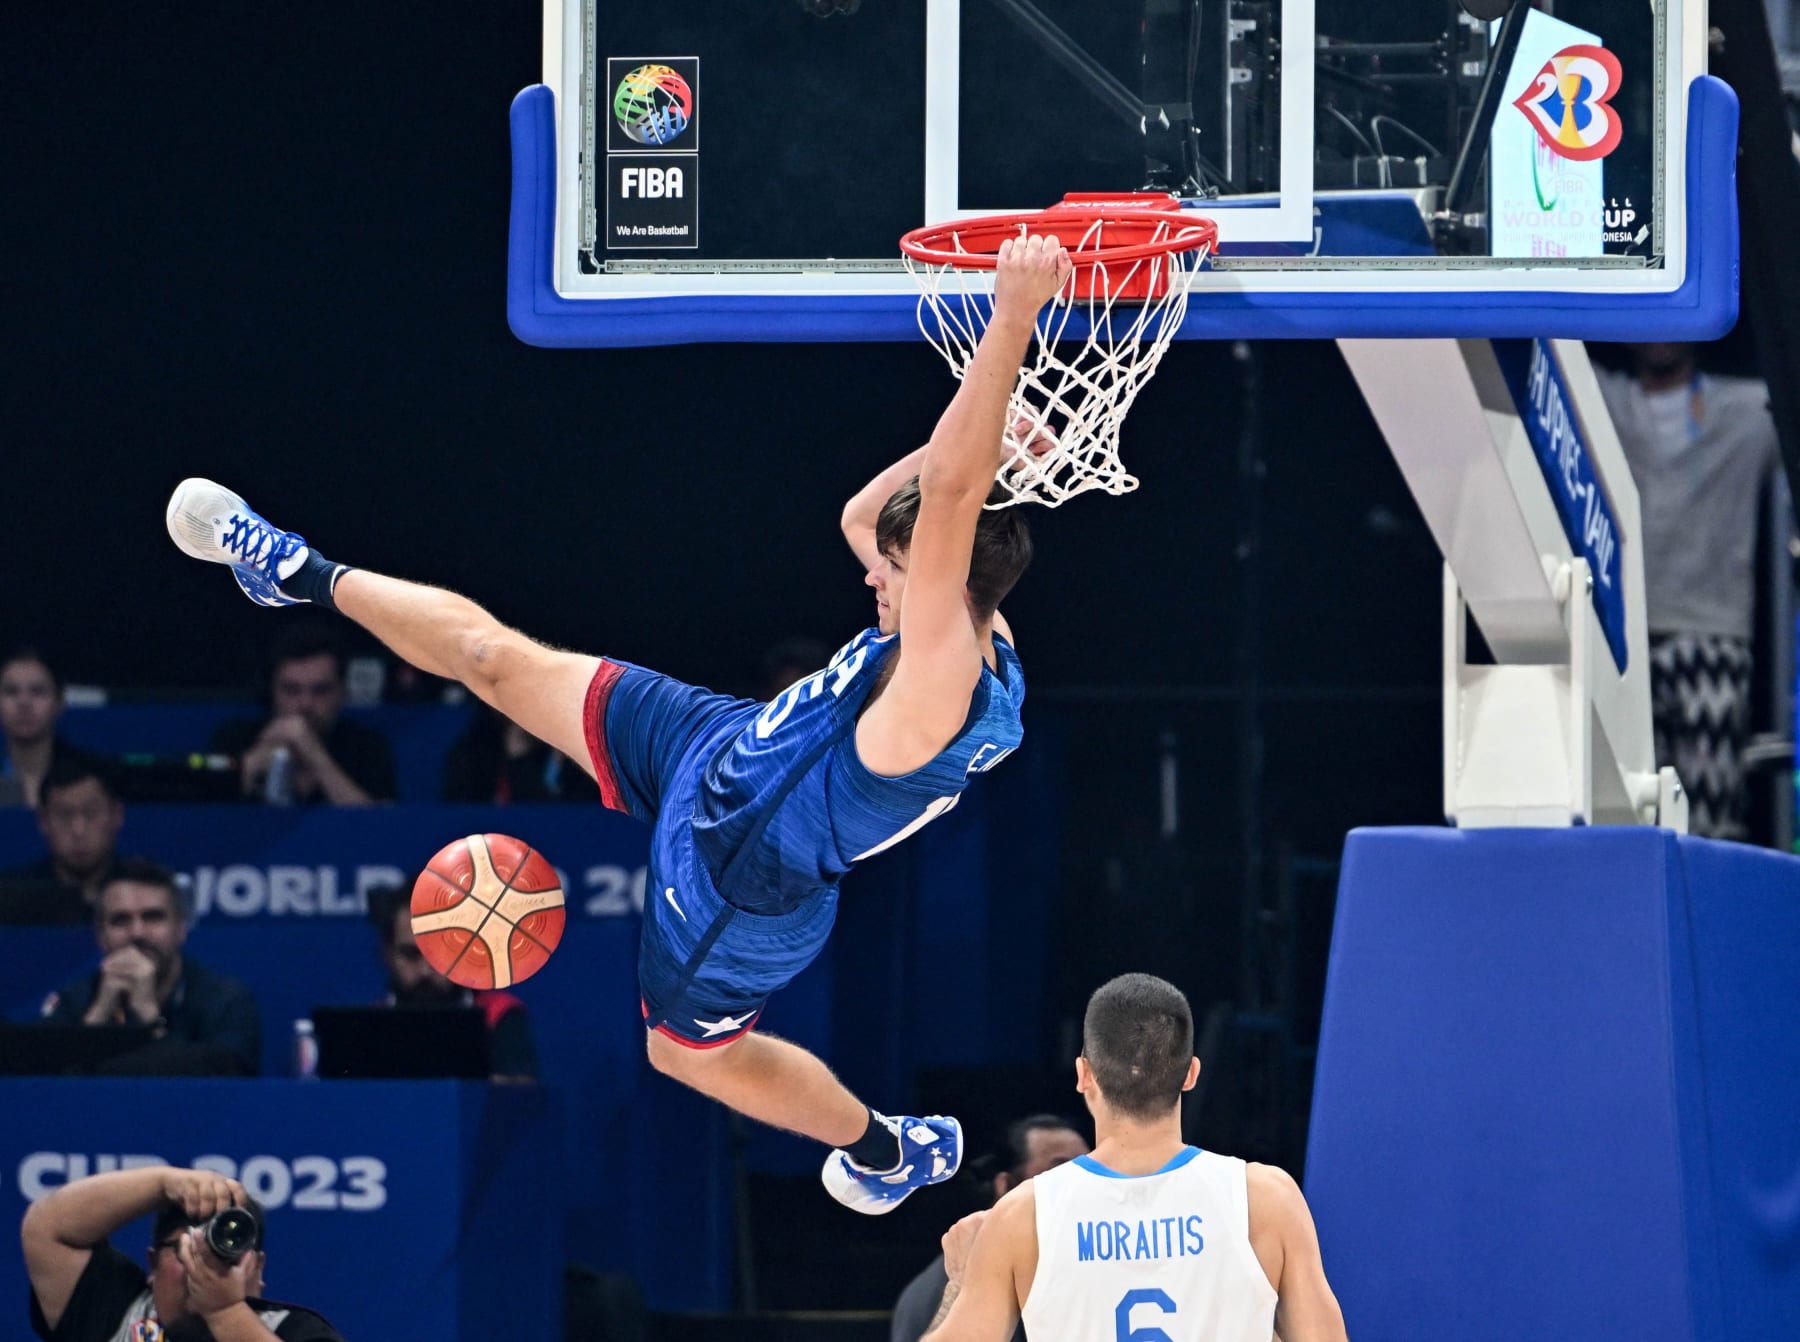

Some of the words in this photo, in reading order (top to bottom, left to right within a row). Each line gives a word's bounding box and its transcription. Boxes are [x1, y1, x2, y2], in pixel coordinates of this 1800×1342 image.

[621, 167, 684, 198] FIBA
[616, 226, 631, 236] We
[632, 226, 647, 236] Are
[648, 225, 689, 236] Basketball
[1590, 209, 1636, 228] CUP
[1077, 1215, 1204, 1262] MORAITIS
[1115, 1287, 1177, 1342] 6
